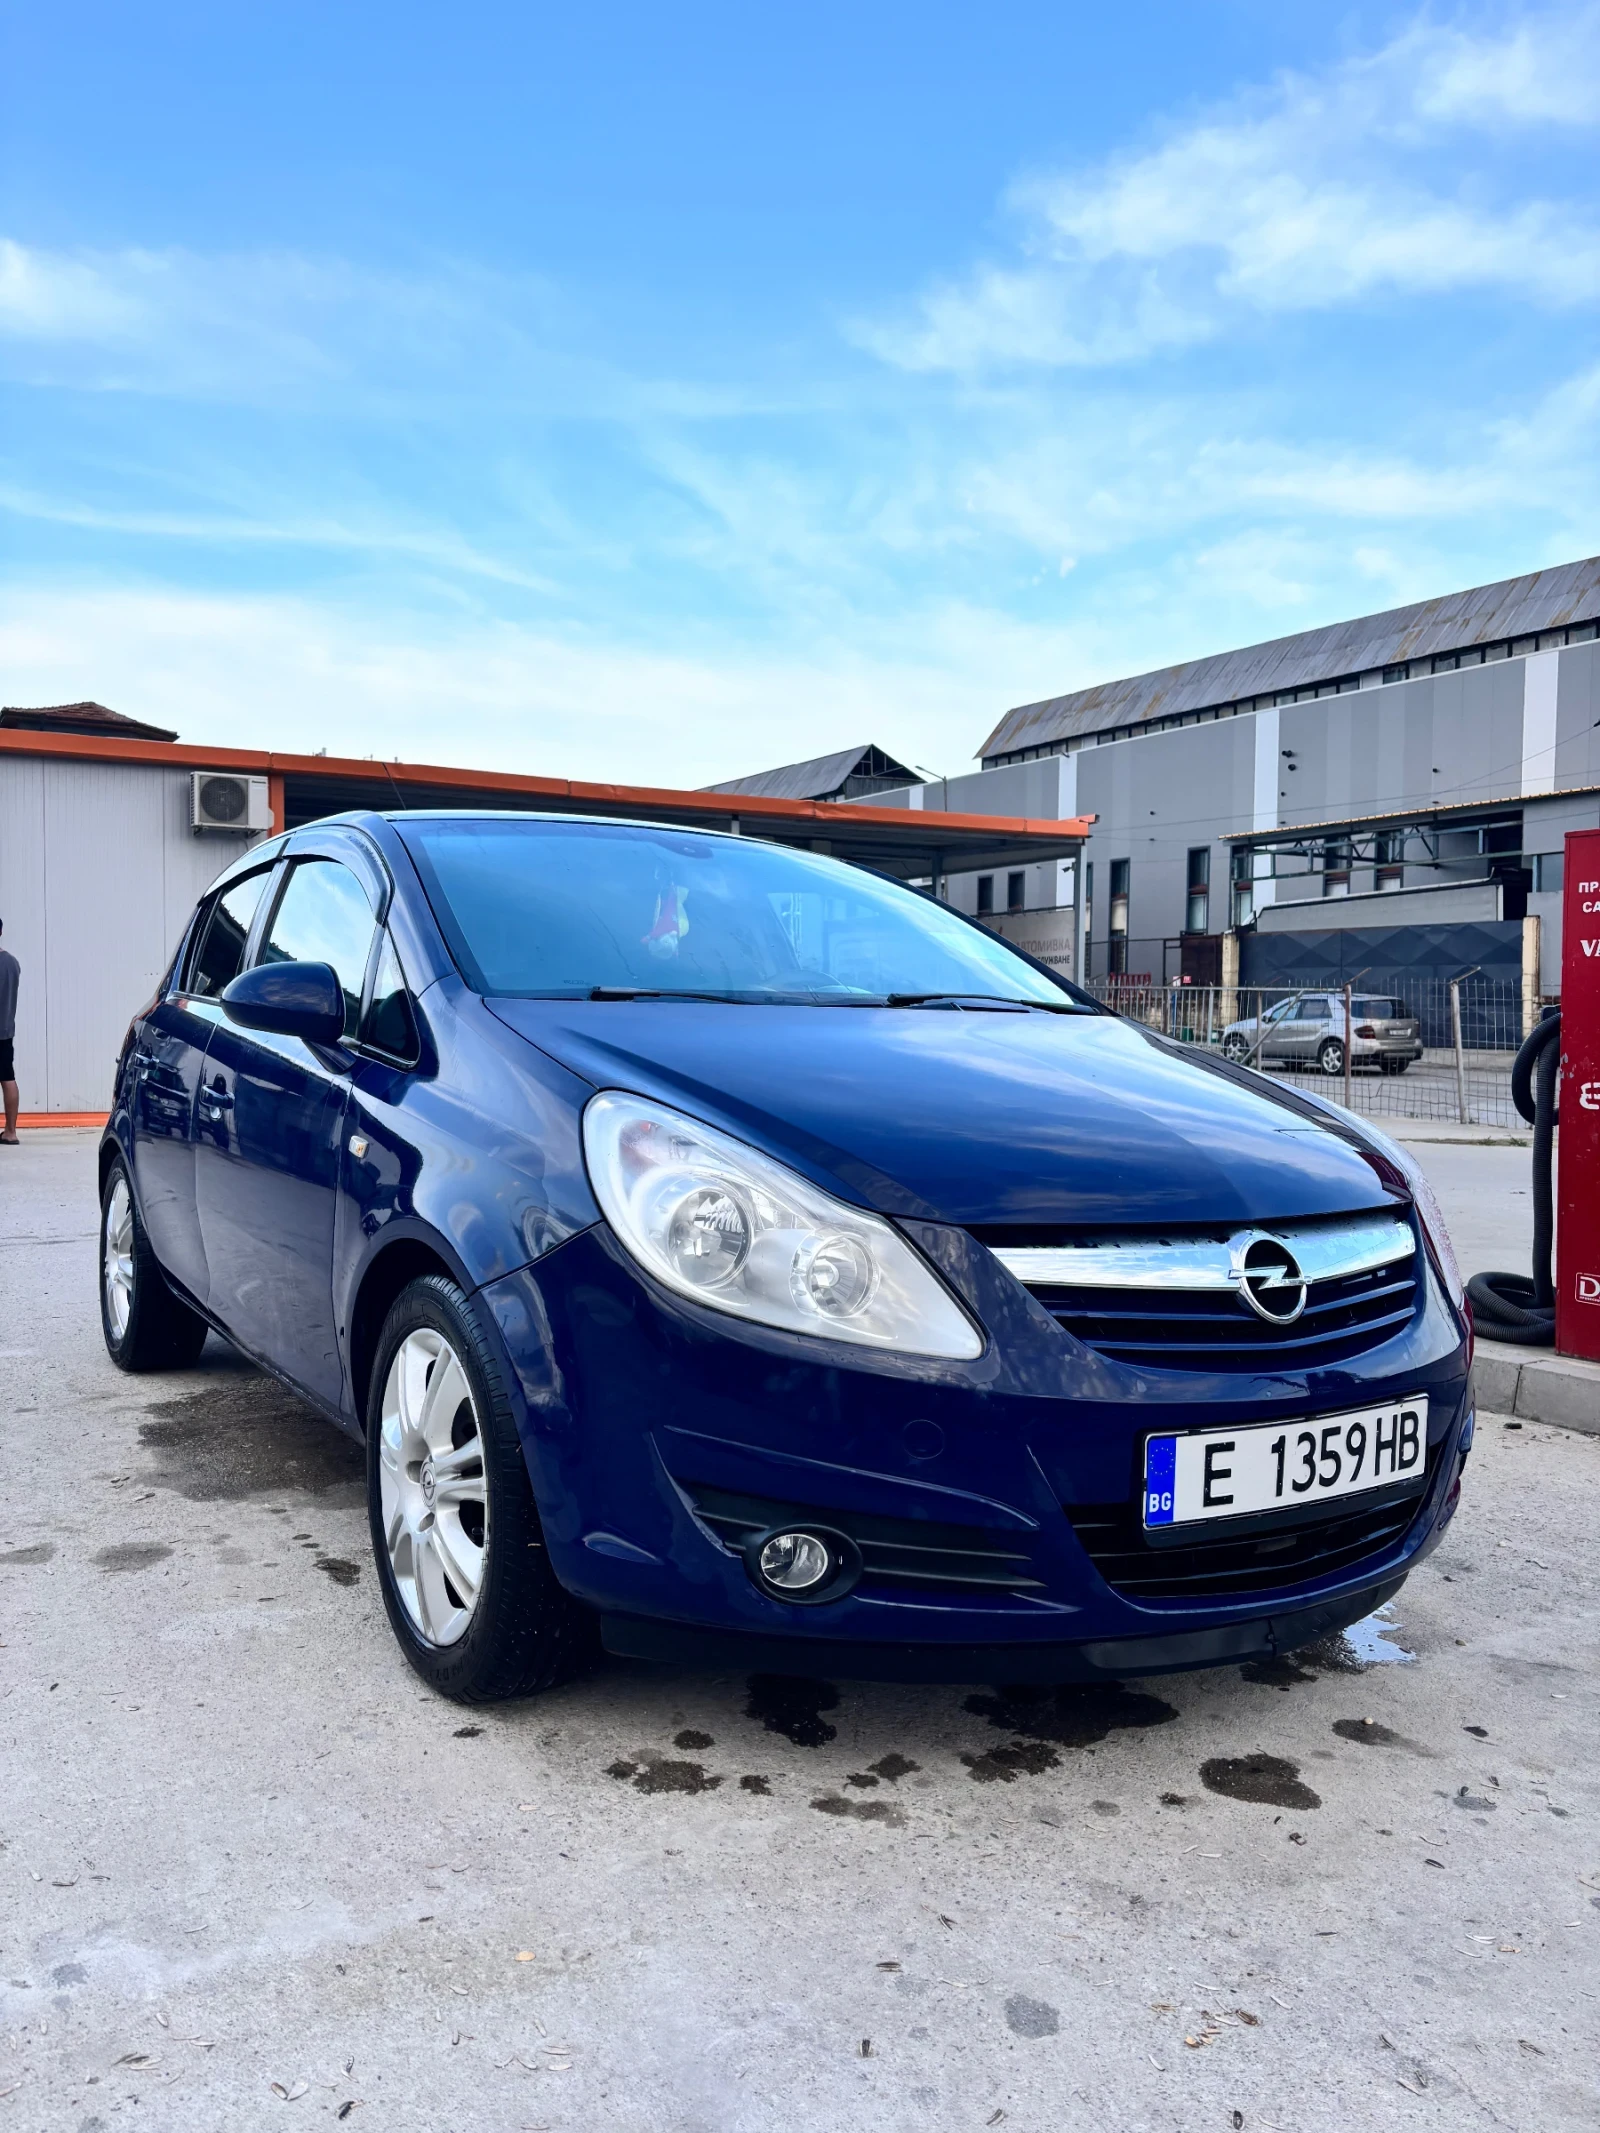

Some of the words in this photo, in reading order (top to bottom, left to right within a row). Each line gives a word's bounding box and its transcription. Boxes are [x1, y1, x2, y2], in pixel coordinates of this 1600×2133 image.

[1579, 882, 1600, 893] ПР
[1203, 1441, 1235, 1508] E
[1149, 1492, 1171, 1513] BG
